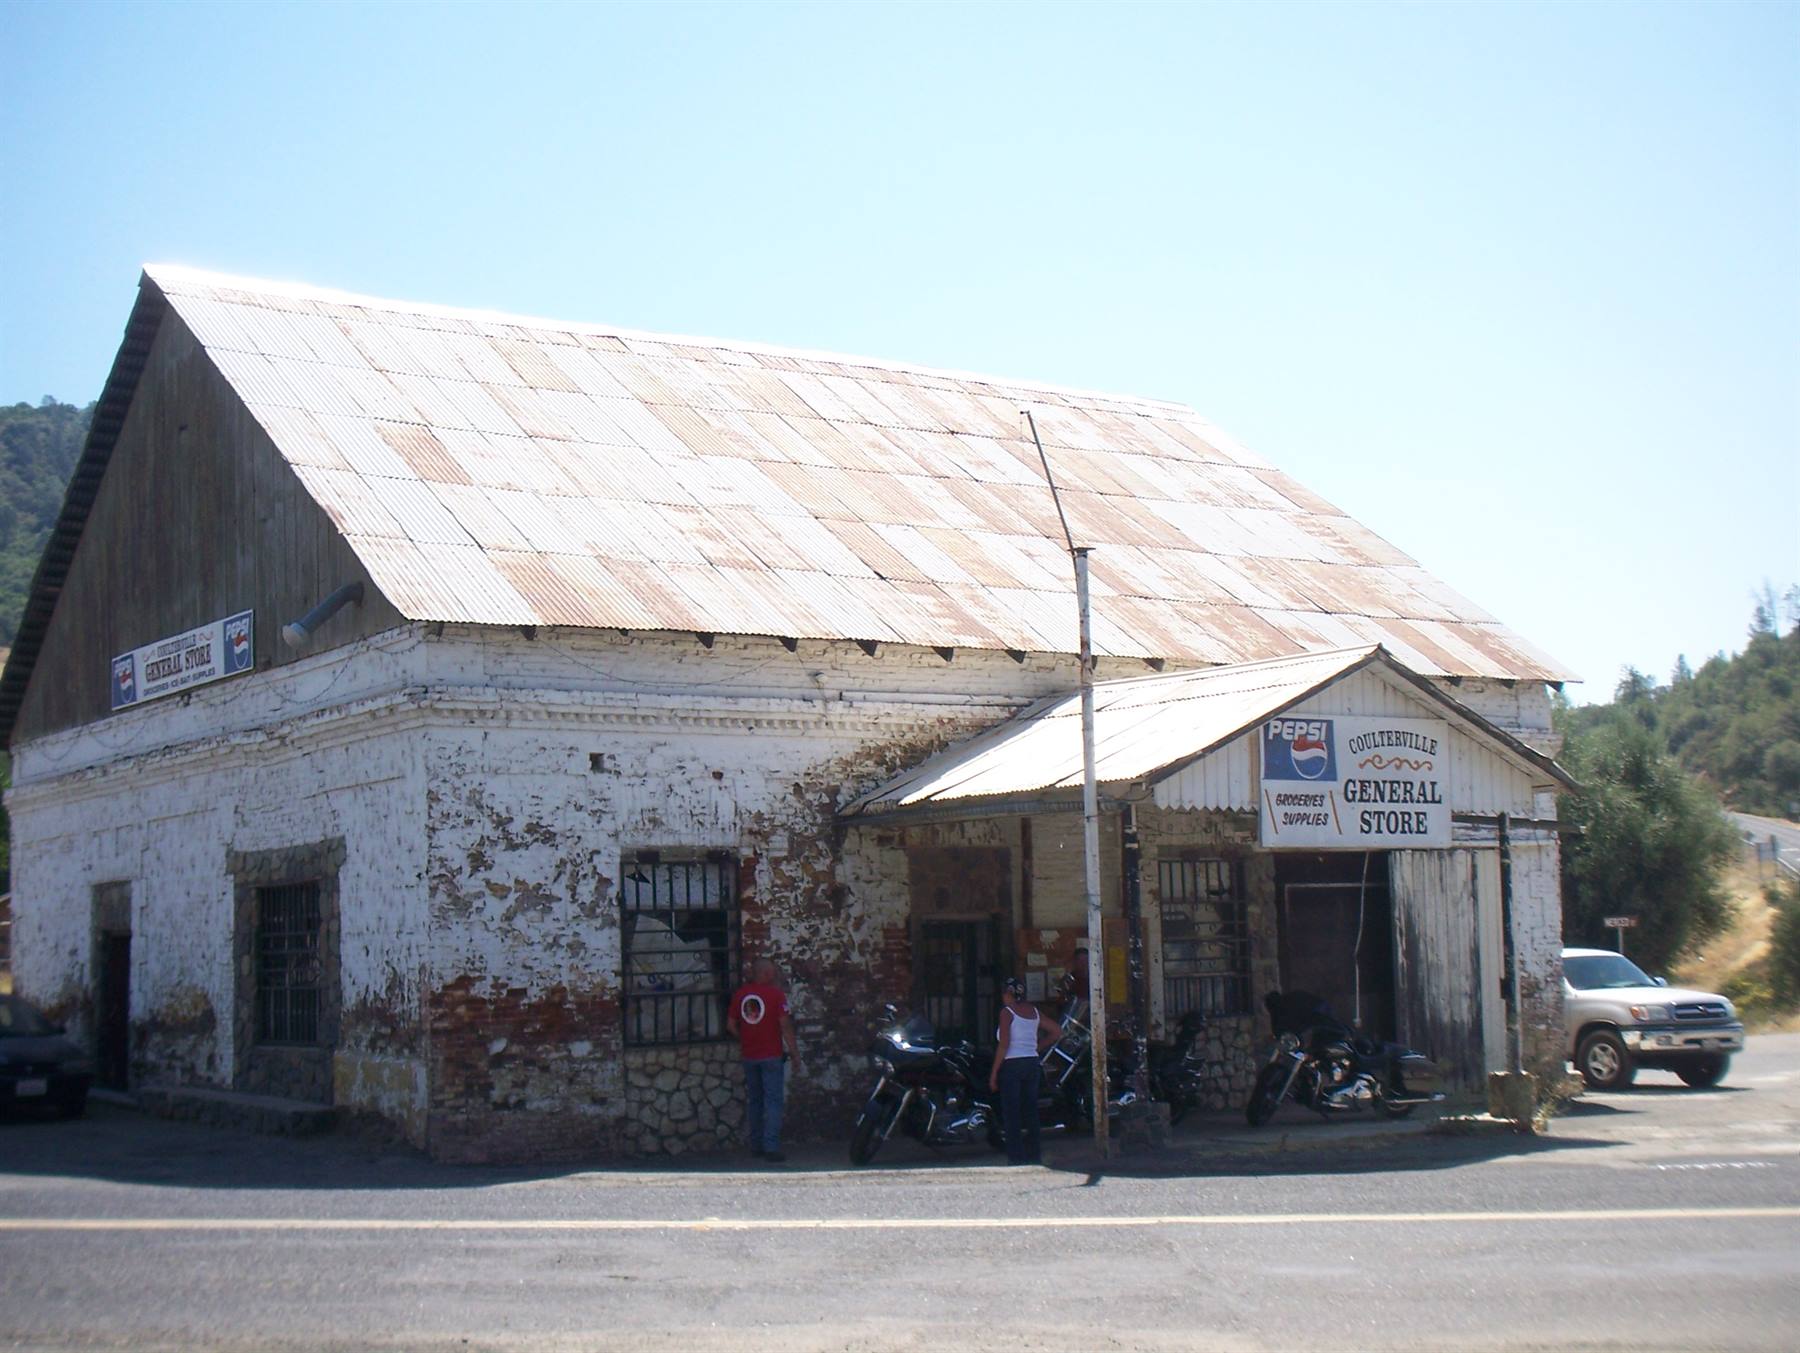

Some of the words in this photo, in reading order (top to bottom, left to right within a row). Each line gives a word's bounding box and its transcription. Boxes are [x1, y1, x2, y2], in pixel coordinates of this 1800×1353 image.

[226, 617, 250, 641] PEPSI
[146, 653, 183, 683] GENERAL
[185, 643, 211, 670] STORE
[1268, 720, 1327, 741] PEPSI
[1348, 730, 1438, 756] COULTERVILLE
[1275, 793, 1325, 808] GROCERIES
[1343, 778, 1442, 804] GENERAL
[1282, 811, 1329, 827] SUPPLIES
[1360, 809, 1428, 834] STORE
